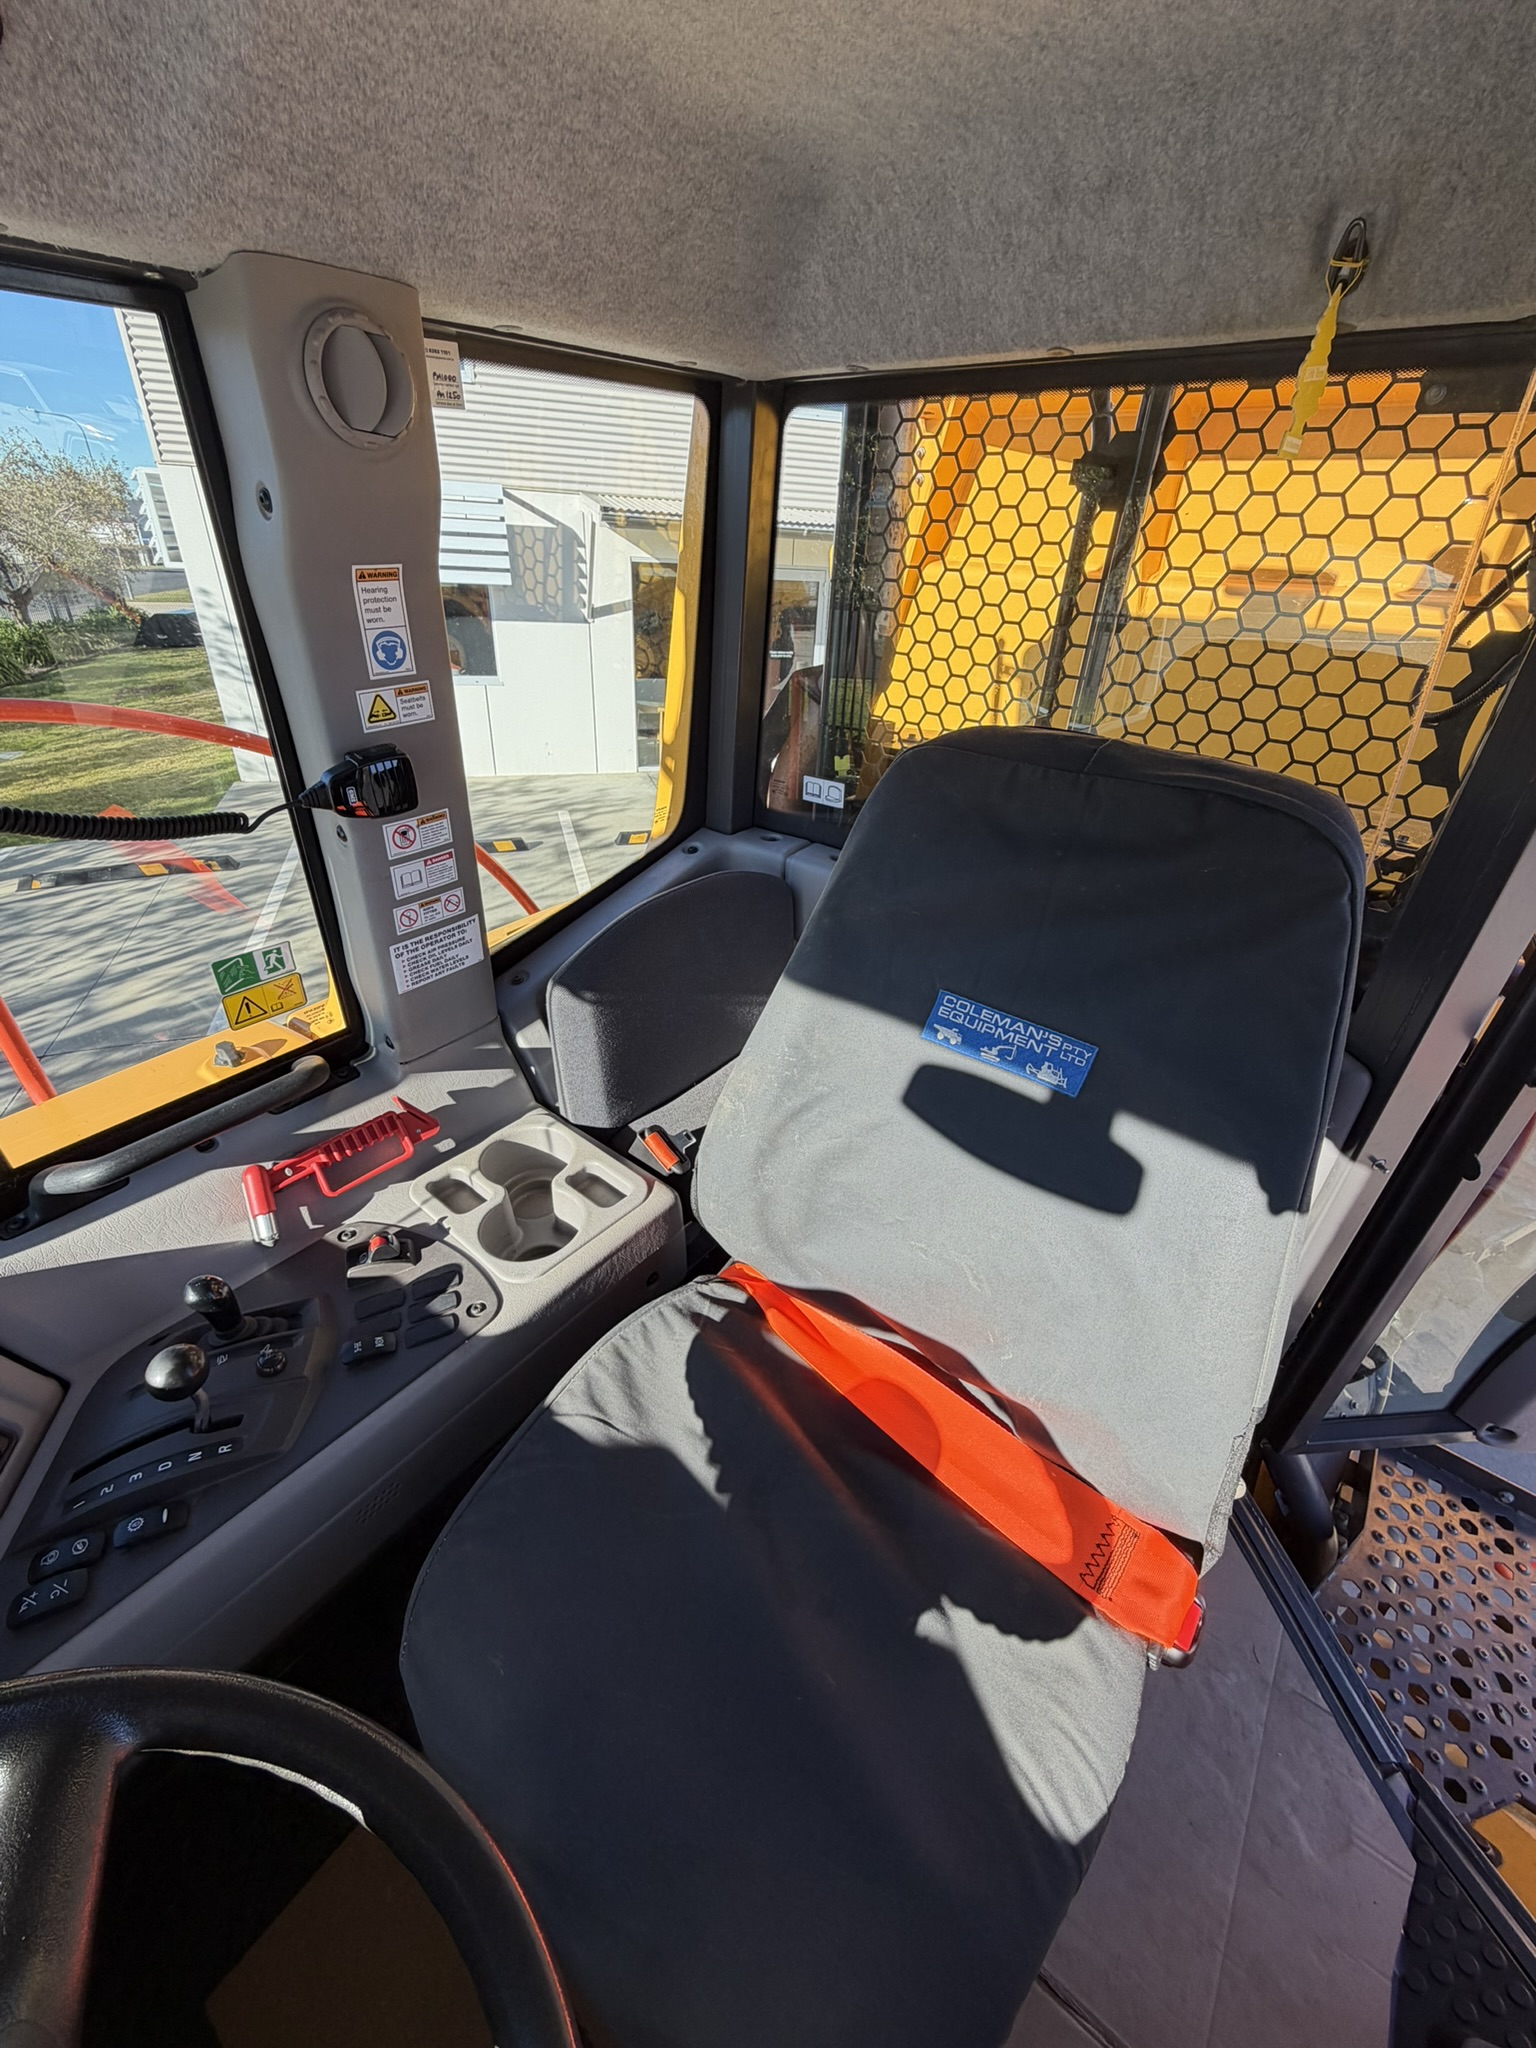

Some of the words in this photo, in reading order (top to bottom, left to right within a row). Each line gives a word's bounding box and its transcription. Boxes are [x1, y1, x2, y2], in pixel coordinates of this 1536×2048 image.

[363, 596, 397, 605] protection
[404, 685, 427, 694] WARNING
[400, 695, 426, 704] Seatbelts
[432, 854, 450, 863] DANGER
[410, 939, 423, 948] THE
[425, 918, 476, 942] RESPONSIBILITY
[406, 947, 419, 955] THE
[421, 933, 456, 950] OPERATOR
[407, 952, 426, 962] CHECK
[438, 936, 465, 950] PRESSURE
[408, 957, 427, 967] CHECK
[438, 945, 457, 955] LEVELS
[459, 939, 473, 947] DAILY
[409, 961, 430, 972] GREASE
[432, 954, 447, 963] DAILY
[410, 967, 429, 976] CHECK
[444, 954, 459, 963] DAILY
[410, 972, 430, 982] CHECK
[431, 964, 449, 974] WATER
[450, 955, 469, 966] LEVELS
[411, 975, 433, 986] REPORT
[446, 962, 465, 972] FAULTS
[943, 995, 1062, 1047] COLEMAN'S
[1062, 1043, 1093, 1059] PTY
[938, 1006, 1058, 1057] EQUIPMENT
[1060, 1053, 1086, 1067] LTD
[188, 1451, 202, 1462] N
[218, 1443, 232, 1454] R
[158, 1461, 172, 1472] D
[129, 1472, 142, 1483] 3
[100, 1484, 114, 1496] 2
